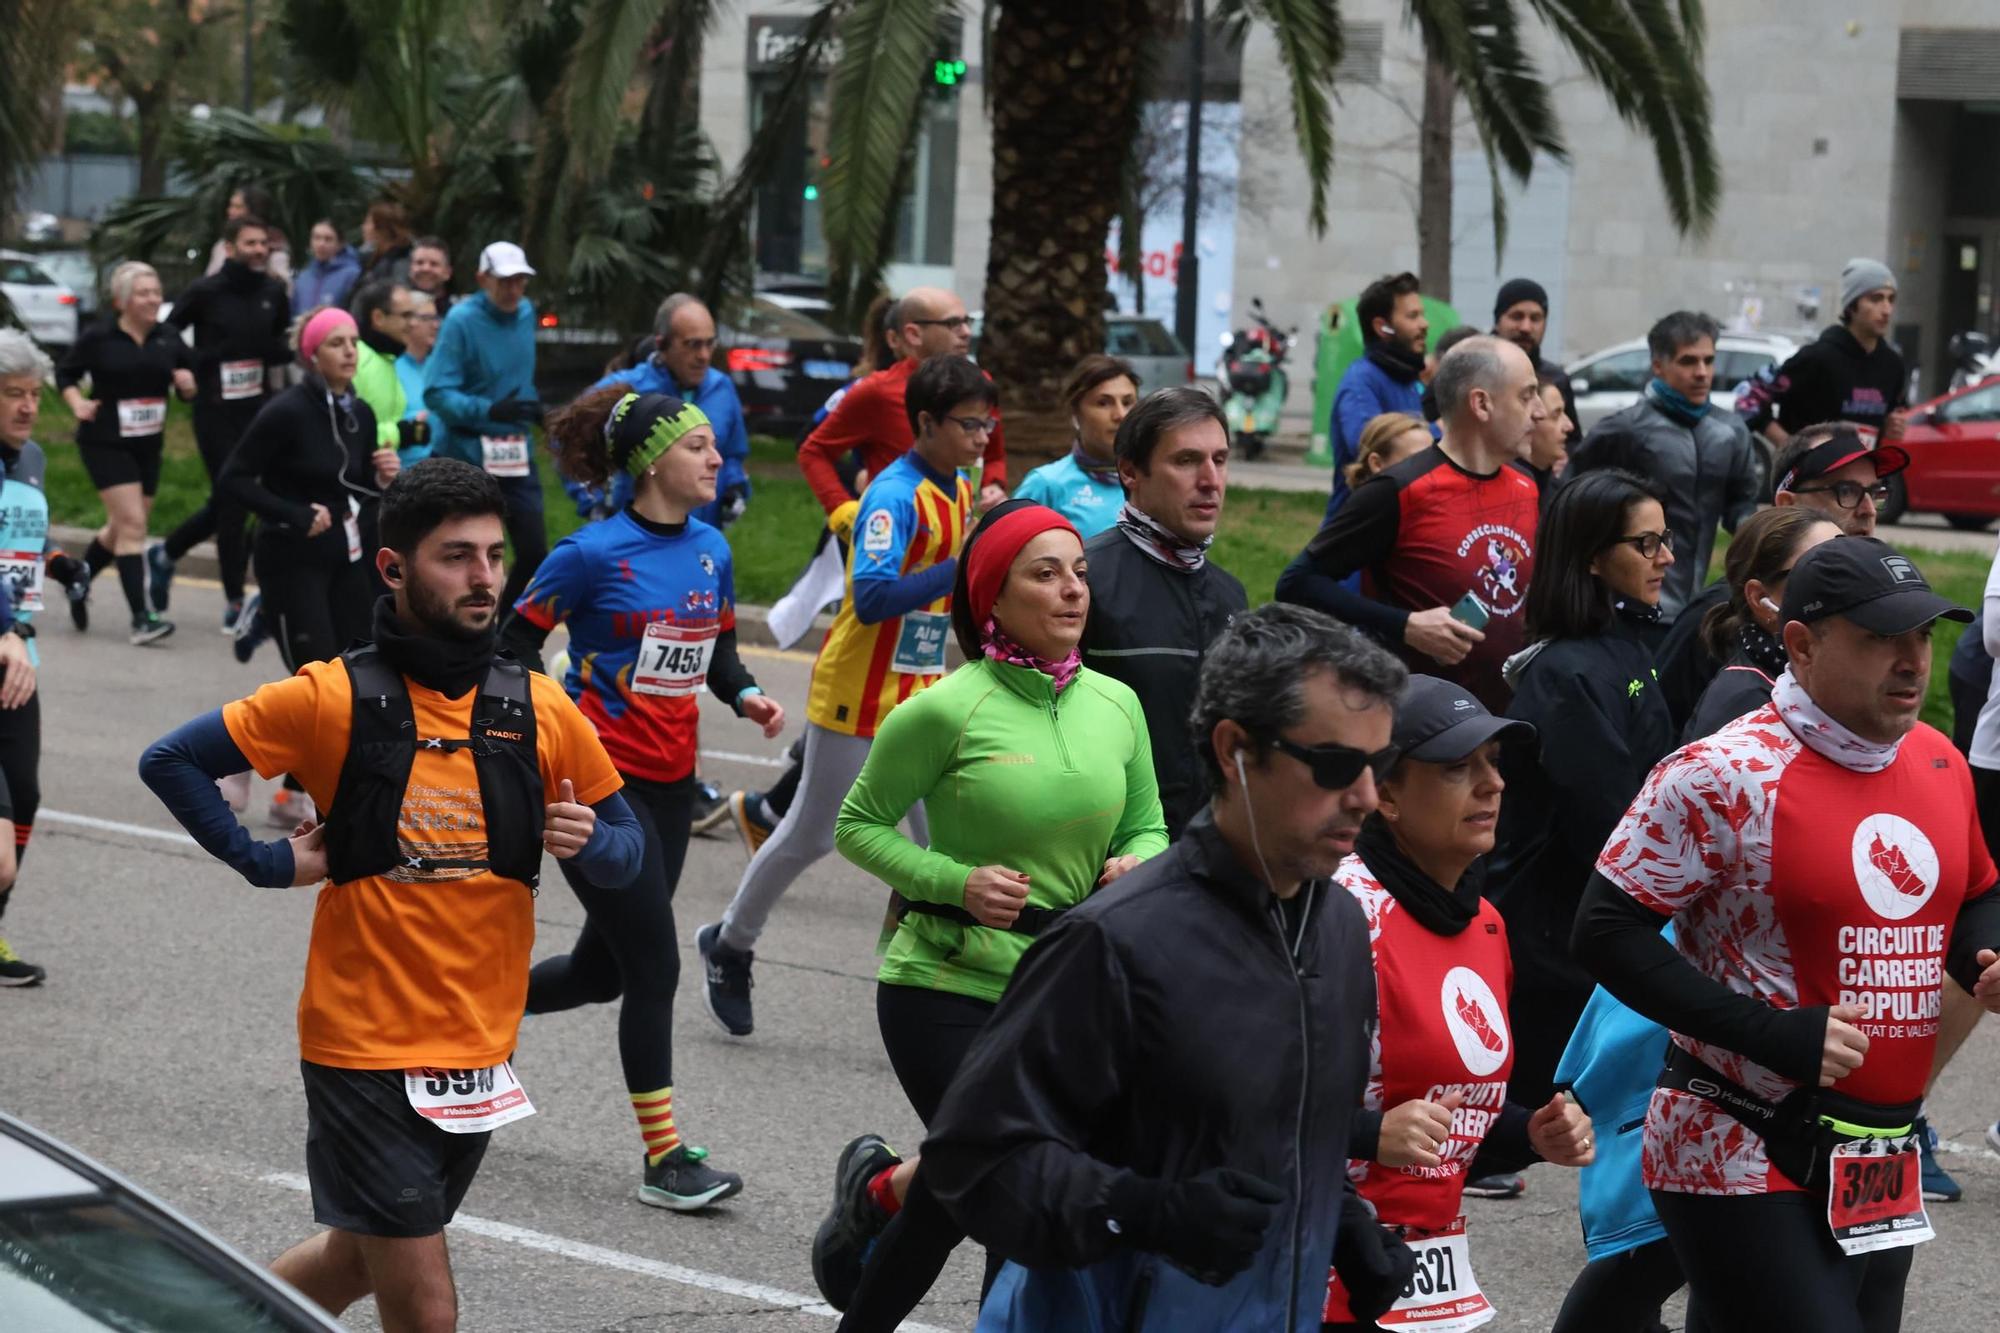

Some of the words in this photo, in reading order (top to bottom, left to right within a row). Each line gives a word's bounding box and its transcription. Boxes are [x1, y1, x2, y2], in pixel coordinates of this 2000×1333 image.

[654, 644, 704, 673] 7453
[486, 729, 522, 741] EVADICT
[1839, 926, 1925, 955] CIRCUIT
[1927, 924, 1945, 952] DE
[1839, 956, 1942, 986] CARRERES
[1889, 1025, 1904, 1038] DE
[1722, 1091, 1775, 1119] Kalenji
